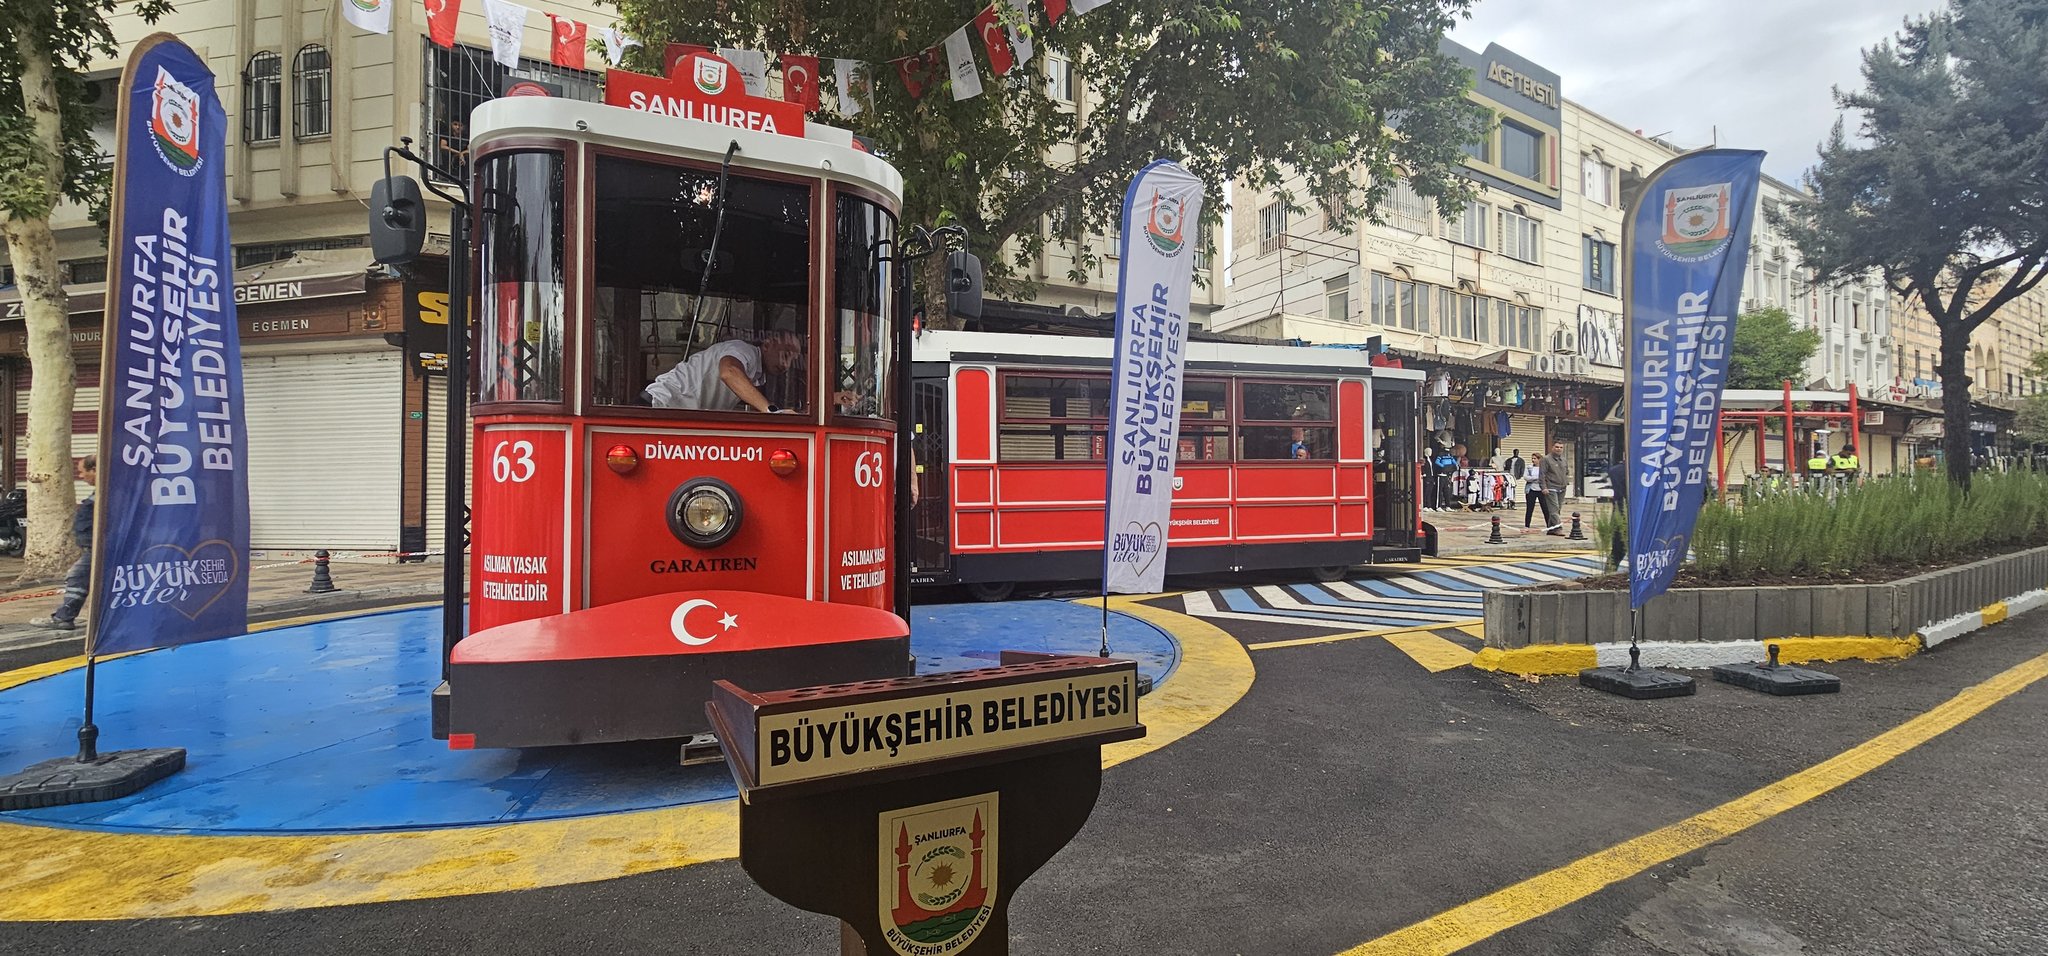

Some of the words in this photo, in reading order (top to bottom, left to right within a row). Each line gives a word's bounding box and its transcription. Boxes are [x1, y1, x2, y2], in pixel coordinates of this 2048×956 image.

[1514, 72, 1559, 109] TEKSTİL
[233, 282, 303, 303] GEMEN
[252, 319, 310, 332] EGEMEN
[187, 253, 233, 471] BELEDİYESİ
[1121, 303, 1148, 467] ŞANLIURFA
[1136, 282, 1169, 496] BÜYÜKŞEHİR
[1157, 312, 1182, 473] BELEDİYESİ
[1663, 290, 1709, 512] BÜYÜKŞEHİR
[1684, 315, 1728, 485] BELEDİYESİ
[1640, 319, 1670, 488] ŞANLIURFA
[491, 440, 536, 483] 63
[645, 441, 764, 462] DİVANYOLU-01
[854, 450, 883, 488] 63
[841, 548, 875, 567] ASILMAK
[1113, 533, 1147, 552] BÜYÜK
[111, 558, 201, 593] BÜYÜK
[201, 571, 230, 585] SEVDA
[513, 556, 548, 574] YASAK
[650, 557, 758, 575] GARATREN
[841, 574, 852, 590] VE
[110, 576, 193, 609] ister
[489, 579, 548, 602] TEHLİKELİDİR
[769, 697, 974, 767] BÜYÜKŞEHİR
[982, 675, 1130, 734] BELEDİYESİ
[914, 826, 967, 846] ŞANLIURFA
[886, 928, 943, 956] BÜYÜKŞEHİR
[944, 904, 992, 952] BELEDİYESİ
